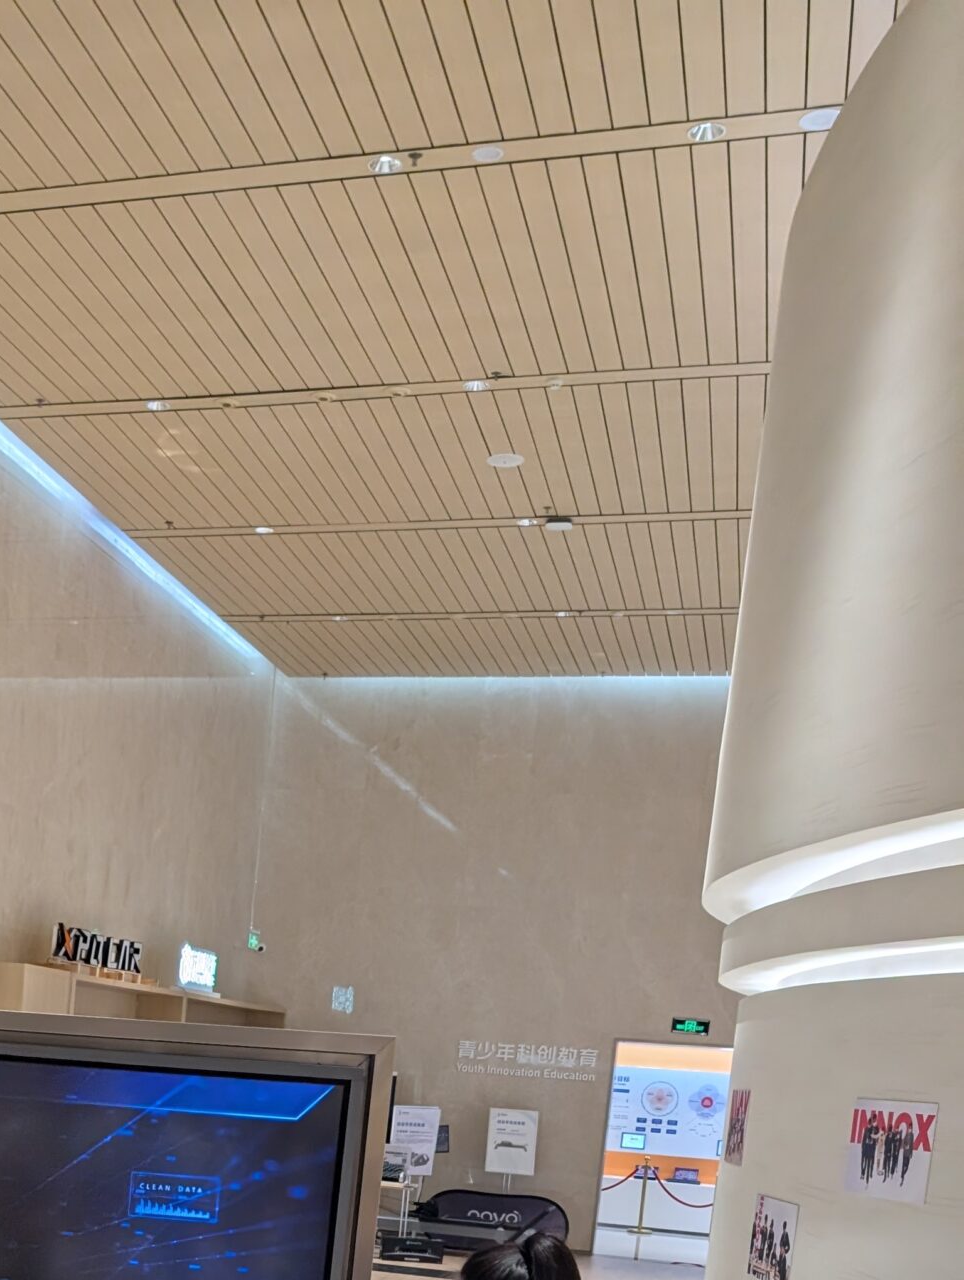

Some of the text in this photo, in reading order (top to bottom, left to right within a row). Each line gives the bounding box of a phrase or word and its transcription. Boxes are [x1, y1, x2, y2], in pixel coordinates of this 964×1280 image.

[458, 1040, 599, 1067] 青少年科创教育
[456, 1062, 596, 1082] Youth Innovation Education
[139, 1182, 203, 1193] CLEAN DATA
